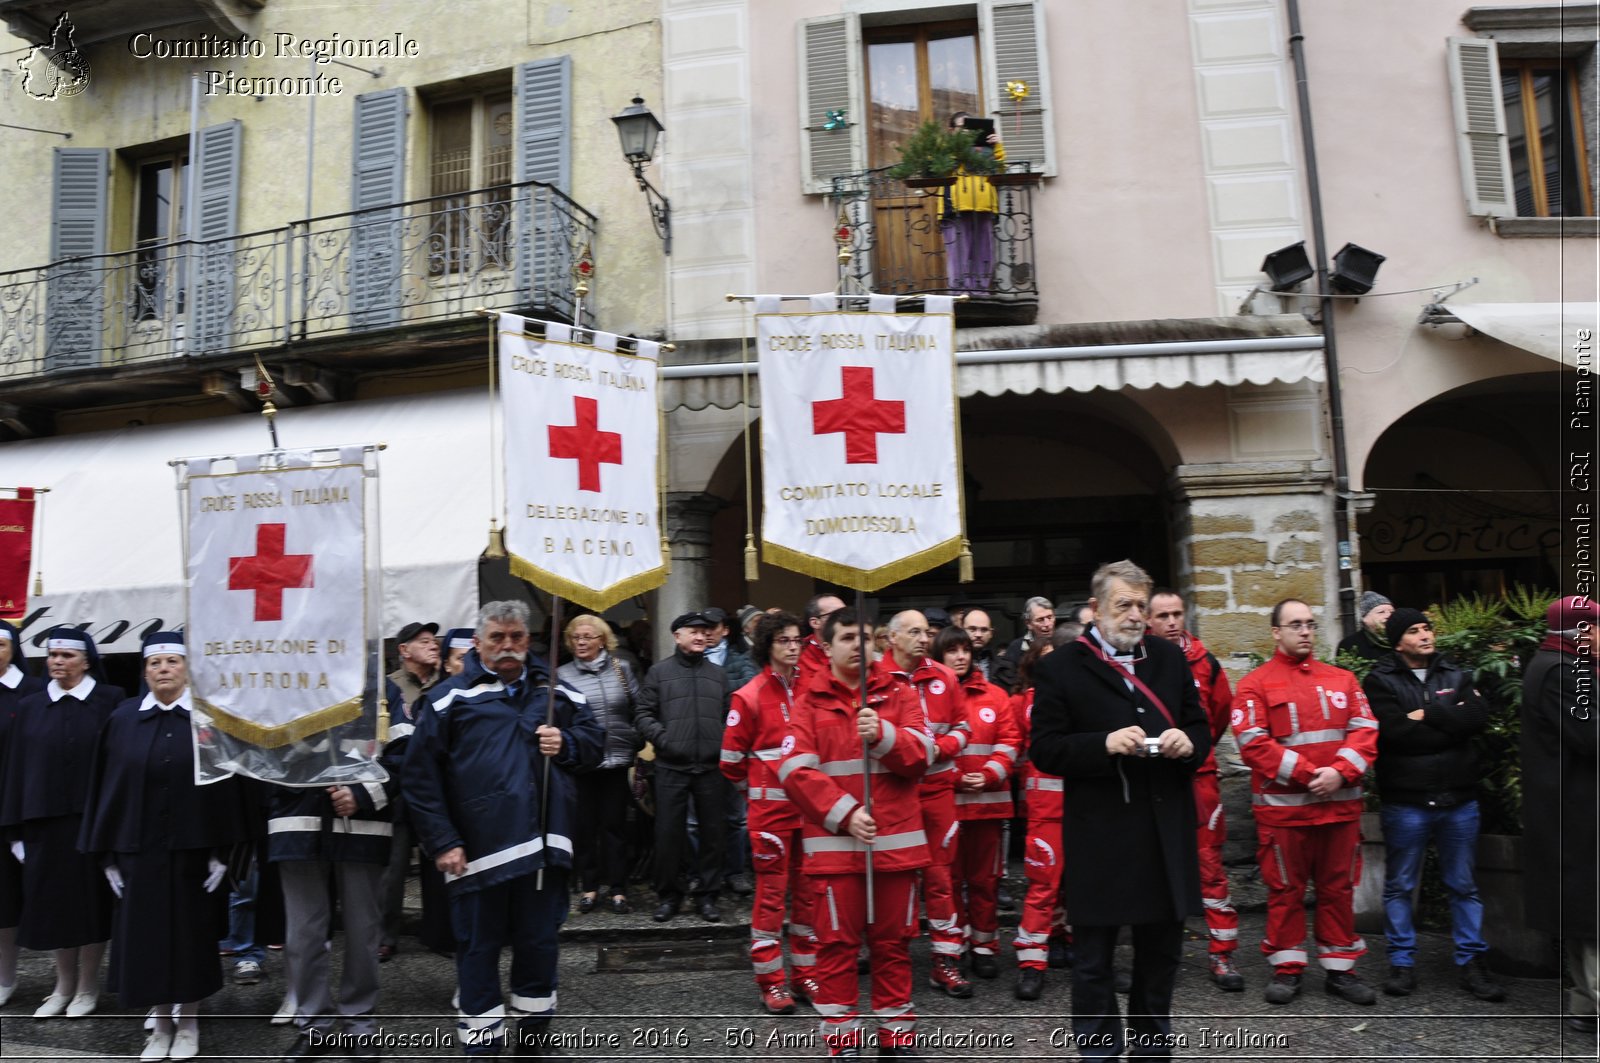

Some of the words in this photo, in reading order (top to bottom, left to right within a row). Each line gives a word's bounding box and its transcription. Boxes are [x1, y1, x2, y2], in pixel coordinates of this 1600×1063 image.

[768, 335, 812, 352] CROCE
[820, 333, 865, 350] ROSSA
[875, 334, 938, 352] ITALIANA
[511, 355, 548, 377] CROCE
[555, 363, 592, 382] ROSSA
[598, 371, 648, 392] ITALIANA
[201, 495, 236, 513] CROCE
[243, 491, 283, 509] ROSSA
[292, 486, 350, 507] ITALIANA
[780, 483, 870, 501] COMITATO
[878, 483, 943, 499] LOCALE
[526, 504, 629, 524] DELEGAZIONE
[636, 512, 650, 527] DI
[807, 516, 918, 536] DOMODOSSOLA
[544, 537, 634, 557] BACENO
[204, 639, 317, 657] DELEGAZIONE
[327, 638, 346, 655] DI
[219, 672, 330, 690] ANTRONA
